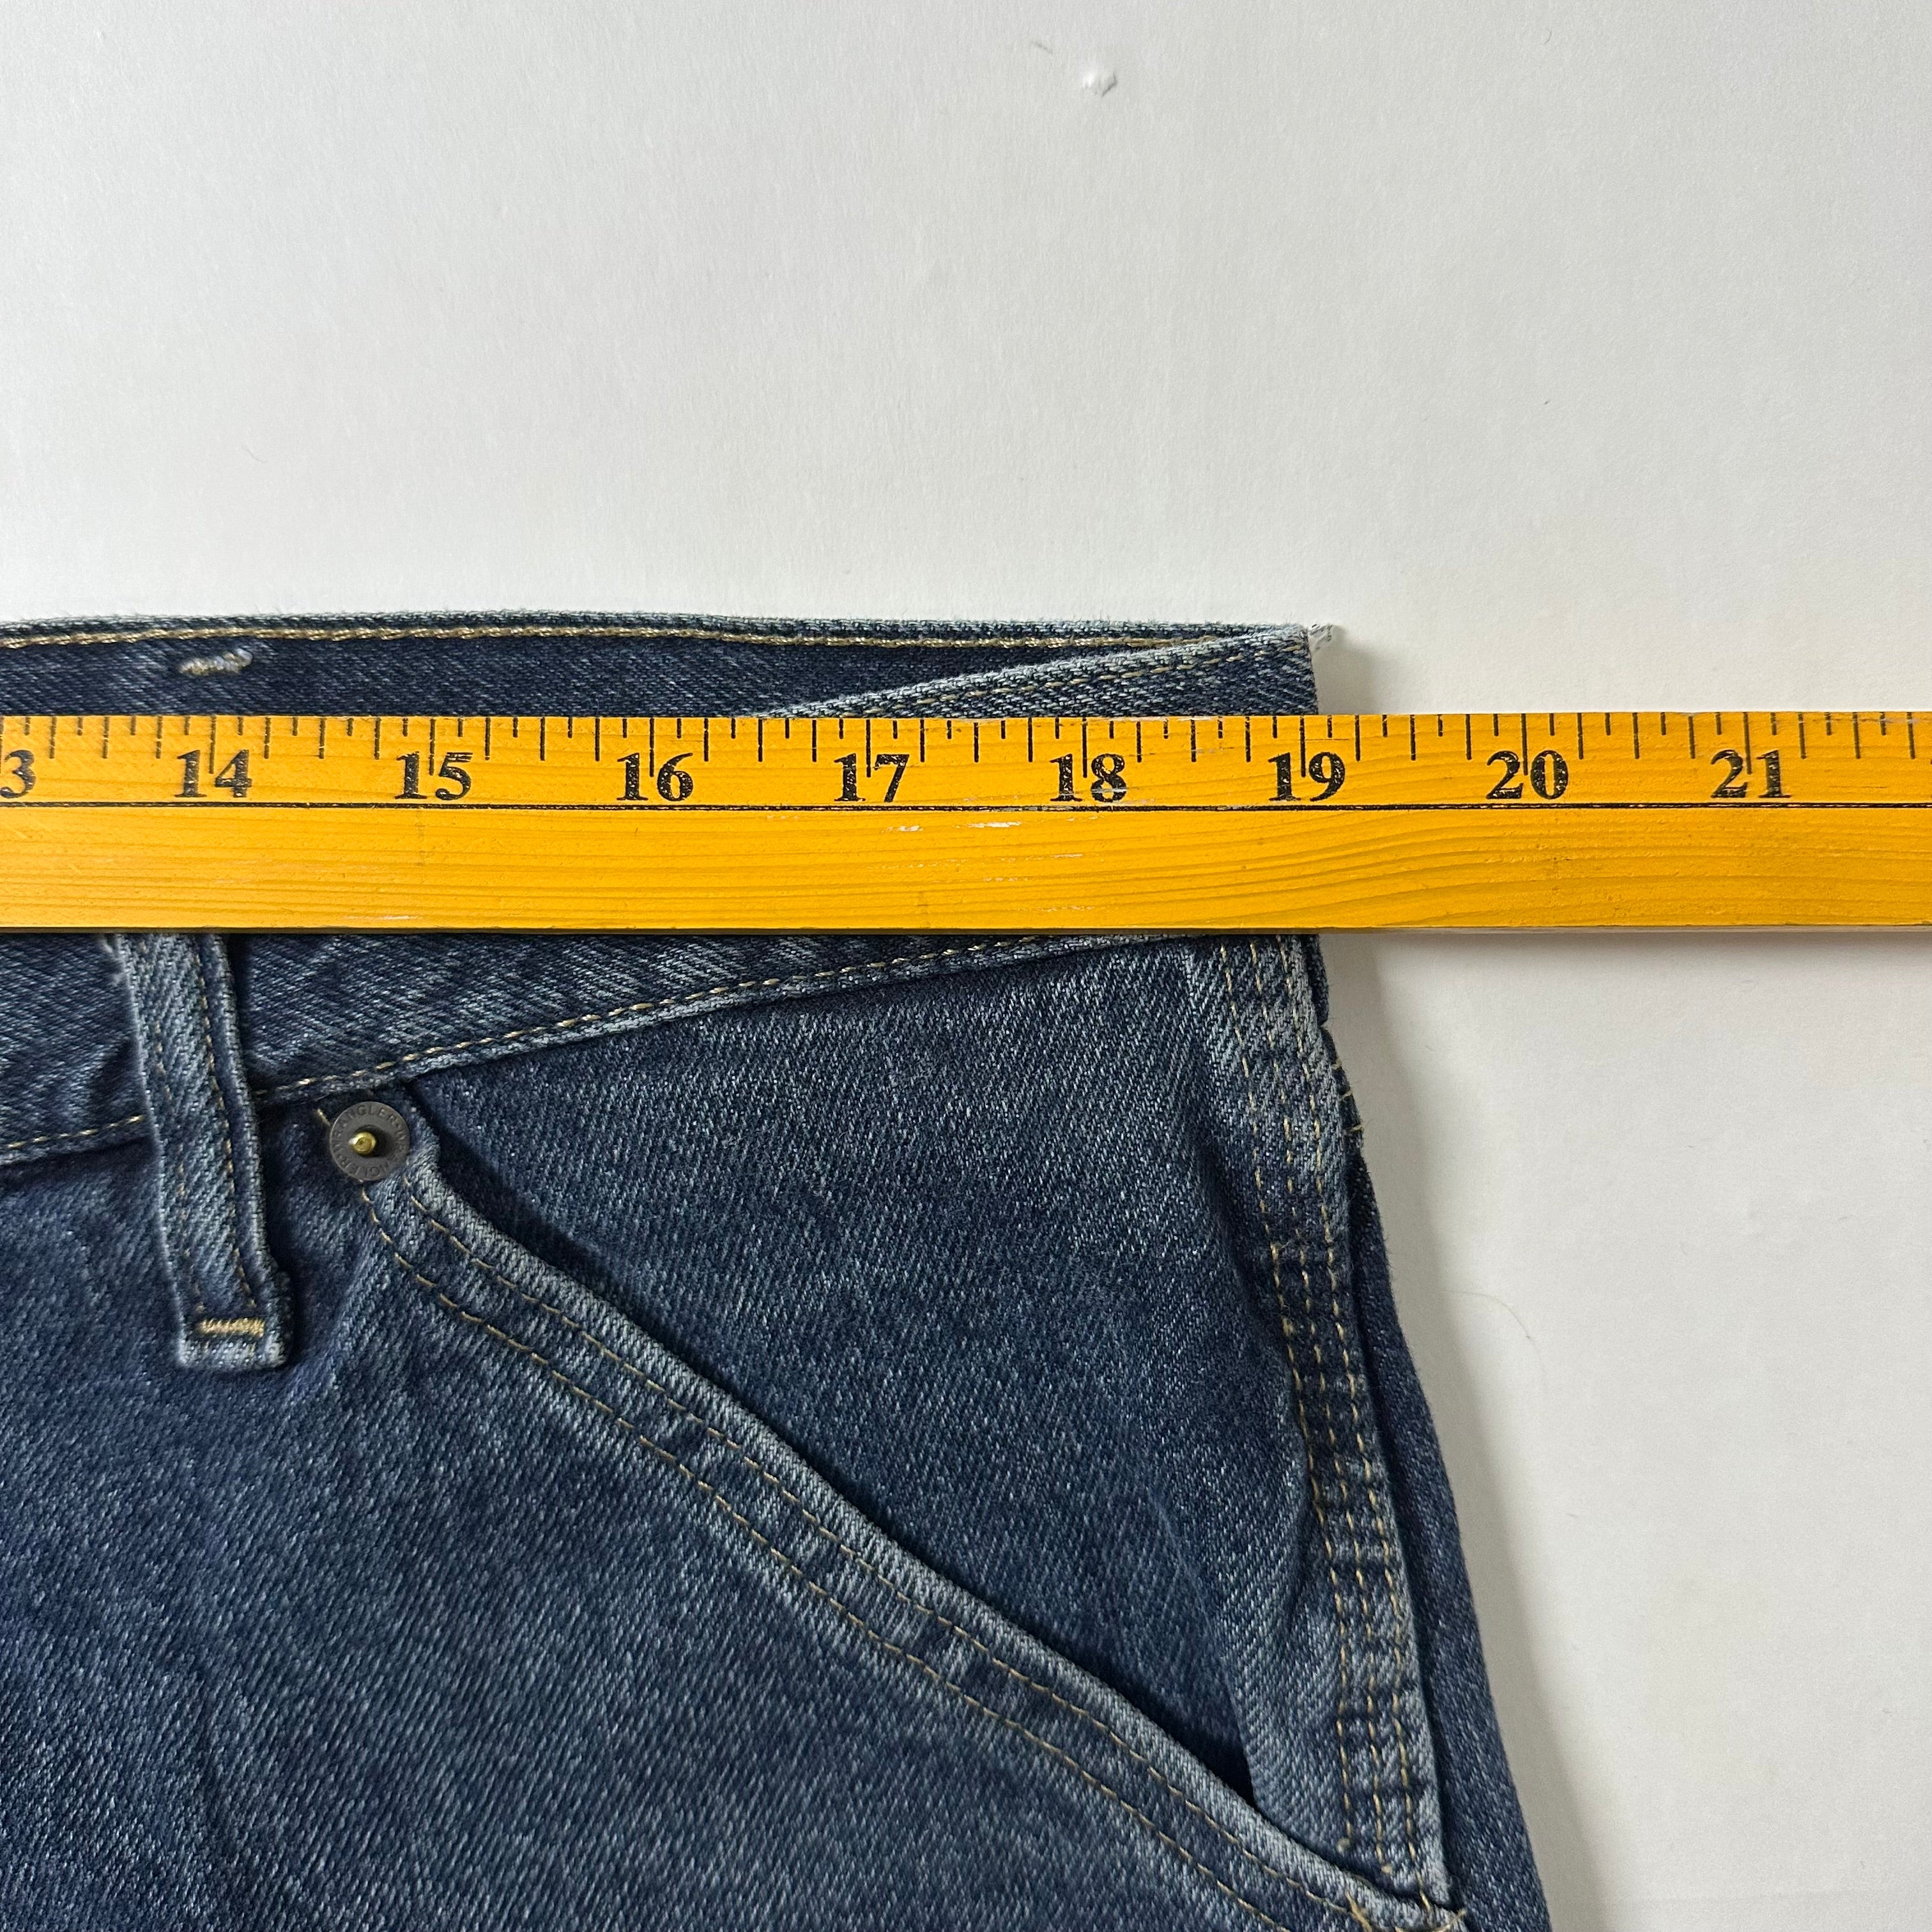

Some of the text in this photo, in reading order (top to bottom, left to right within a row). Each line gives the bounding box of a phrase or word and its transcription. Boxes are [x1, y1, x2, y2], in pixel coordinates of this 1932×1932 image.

[1, 749, 1791, 802] 3 14 15 16 17 18 19 20 21
